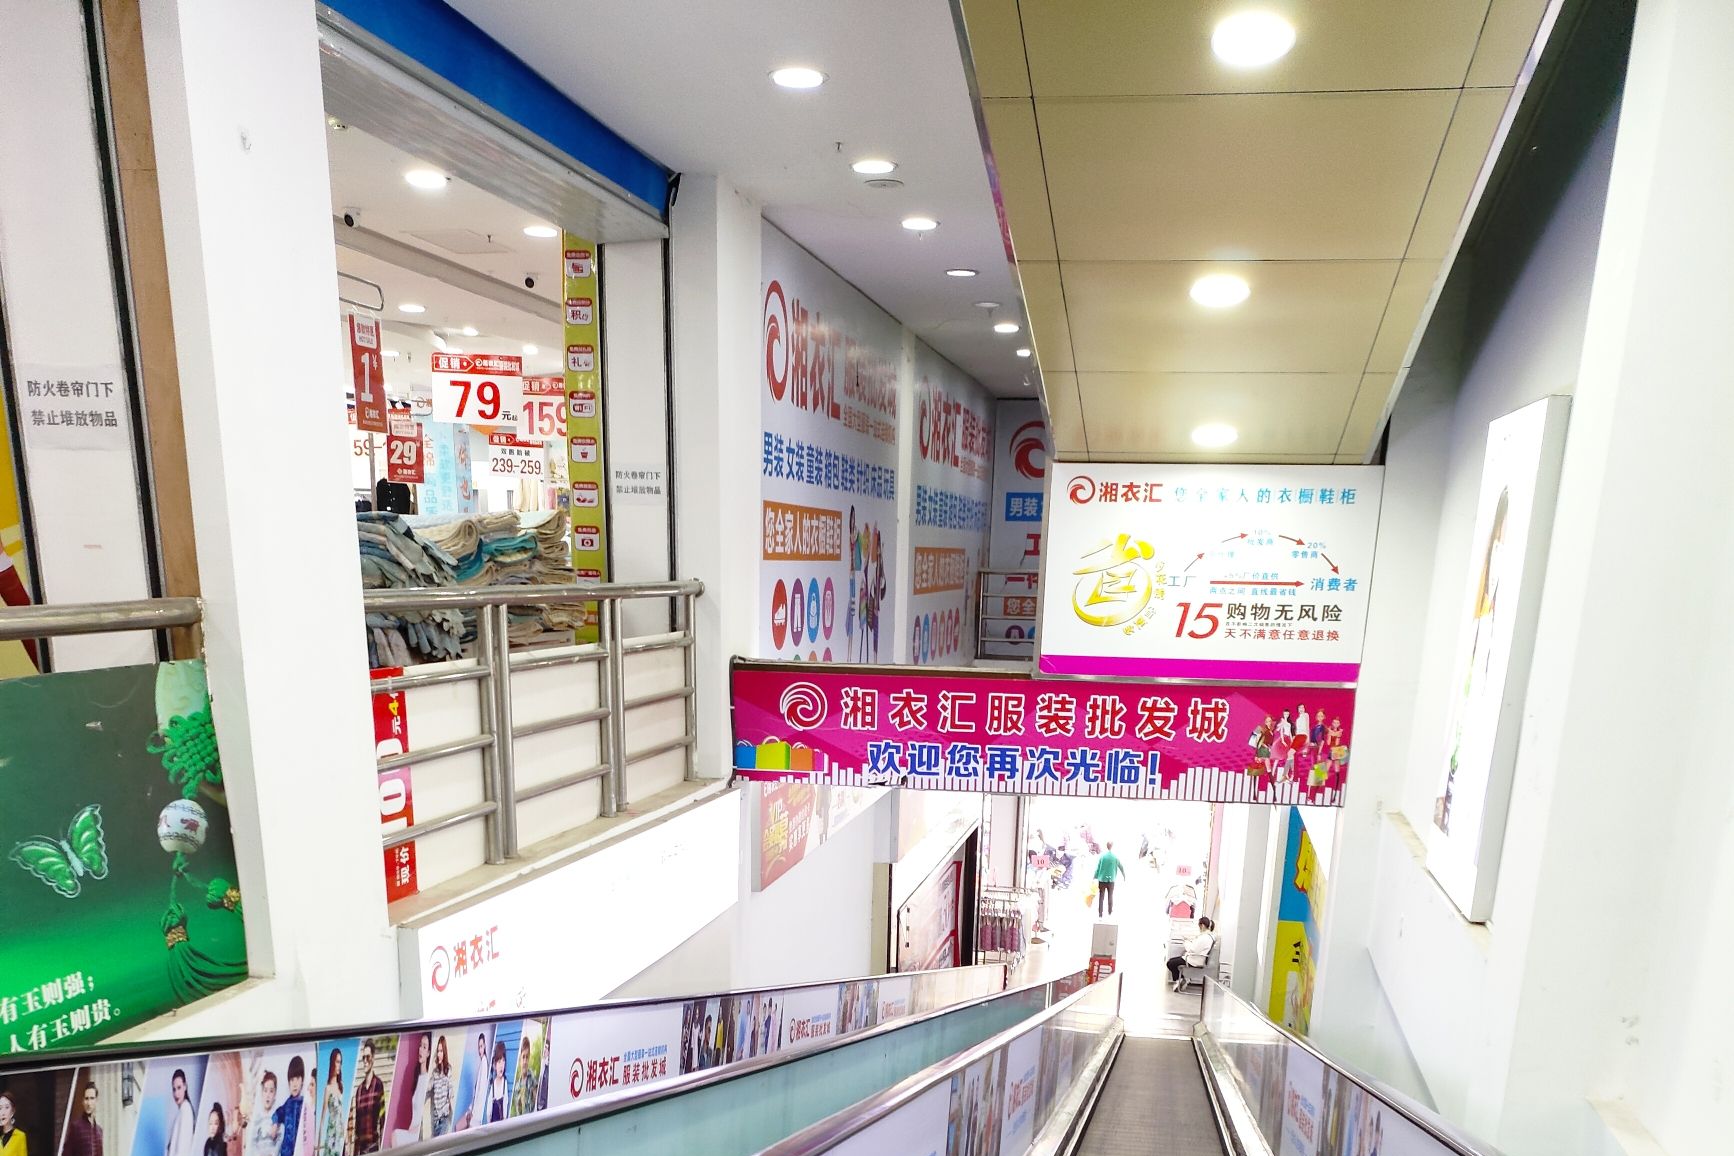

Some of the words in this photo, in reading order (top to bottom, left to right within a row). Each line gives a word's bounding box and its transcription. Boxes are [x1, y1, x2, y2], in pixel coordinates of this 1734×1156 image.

[438, 357, 461, 369] 促销
[791, 299, 841, 421] 湘衣汇
[27, 379, 115, 399] 防火卷帘门下
[361, 353, 374, 402] 1
[449, 380, 501, 420] 79
[31, 409, 119, 428] 禁止堆放物品
[522, 401, 567, 438] 159
[931, 386, 961, 468] 湘衣汇
[389, 440, 417, 465] 29
[615, 470, 662, 480] 防火卷帘门下
[616, 485, 662, 495] 禁止堆放物品
[1098, 482, 1163, 503] 湘衣汇
[1009, 497, 1043, 516] 男装
[764, 507, 842, 555] 您全家人的衣橱鞋柜
[1291, 550, 1319, 559] 零售商
[1167, 575, 1197, 587] 工厂
[1310, 577, 1358, 592] 消费者
[1175, 602, 1223, 640] 15
[1226, 602, 1343, 622] 购物无风险
[1224, 628, 1340, 642] 天不满意任意退换
[840, 688, 1229, 743] 湘衣汇服装批发城
[453, 925, 499, 978] 湘衣汇
[585, 1055, 620, 1093] 湘衣汇
[622, 1056, 667, 1086] 服装批发城
